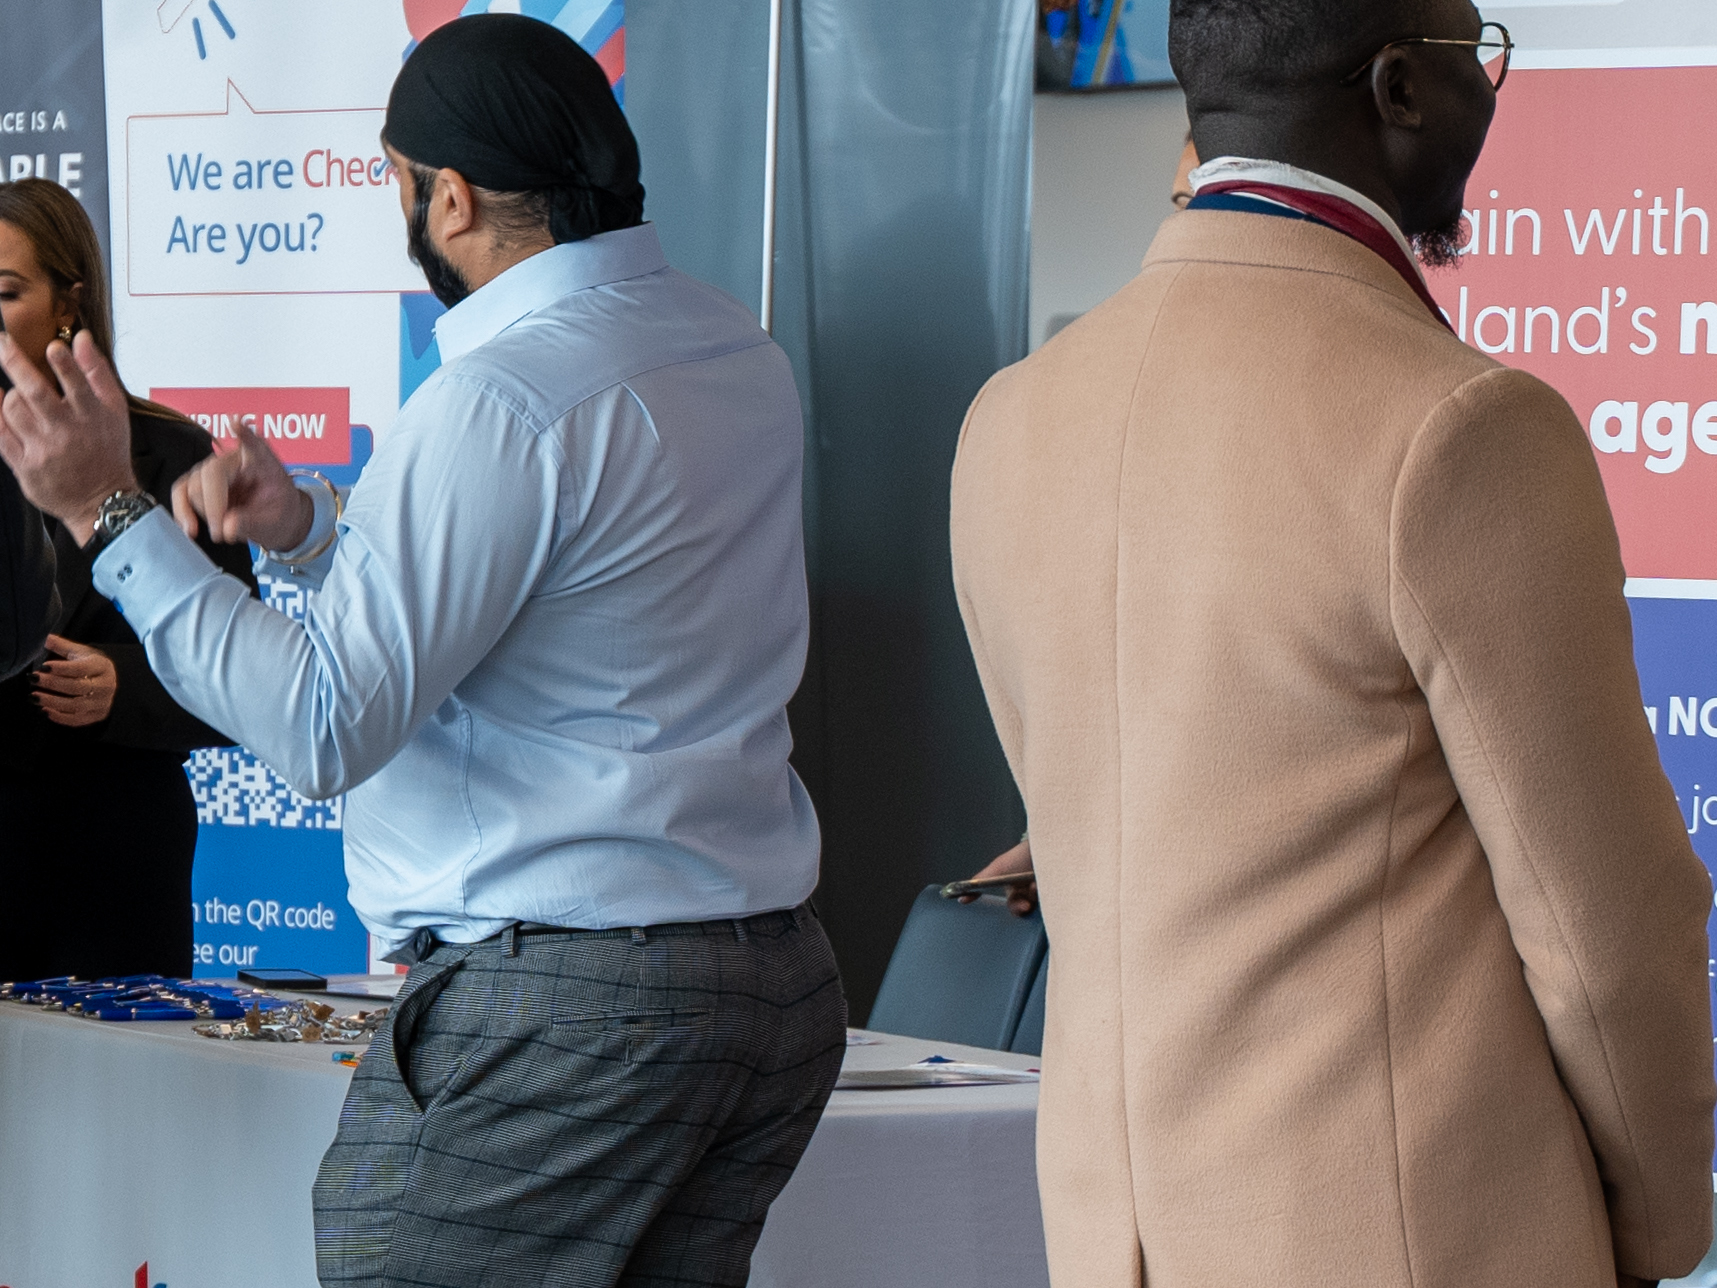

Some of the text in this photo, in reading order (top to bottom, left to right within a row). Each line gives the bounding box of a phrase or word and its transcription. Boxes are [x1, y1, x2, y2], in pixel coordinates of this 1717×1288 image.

[30, 110, 46, 130] IS
[52, 110, 67, 130] A
[166, 148, 401, 191] We are Check
[165, 212, 324, 265] Are you?
[1461, 188, 1542, 256] ain
[1563, 187, 1709, 256] with
[1442, 286, 1658, 355] land’s
[263, 413, 326, 440] NOW
[204, 897, 242, 925] the
[245, 899, 280, 932] QR
[284, 901, 336, 930] code
[218, 943, 259, 966] our
